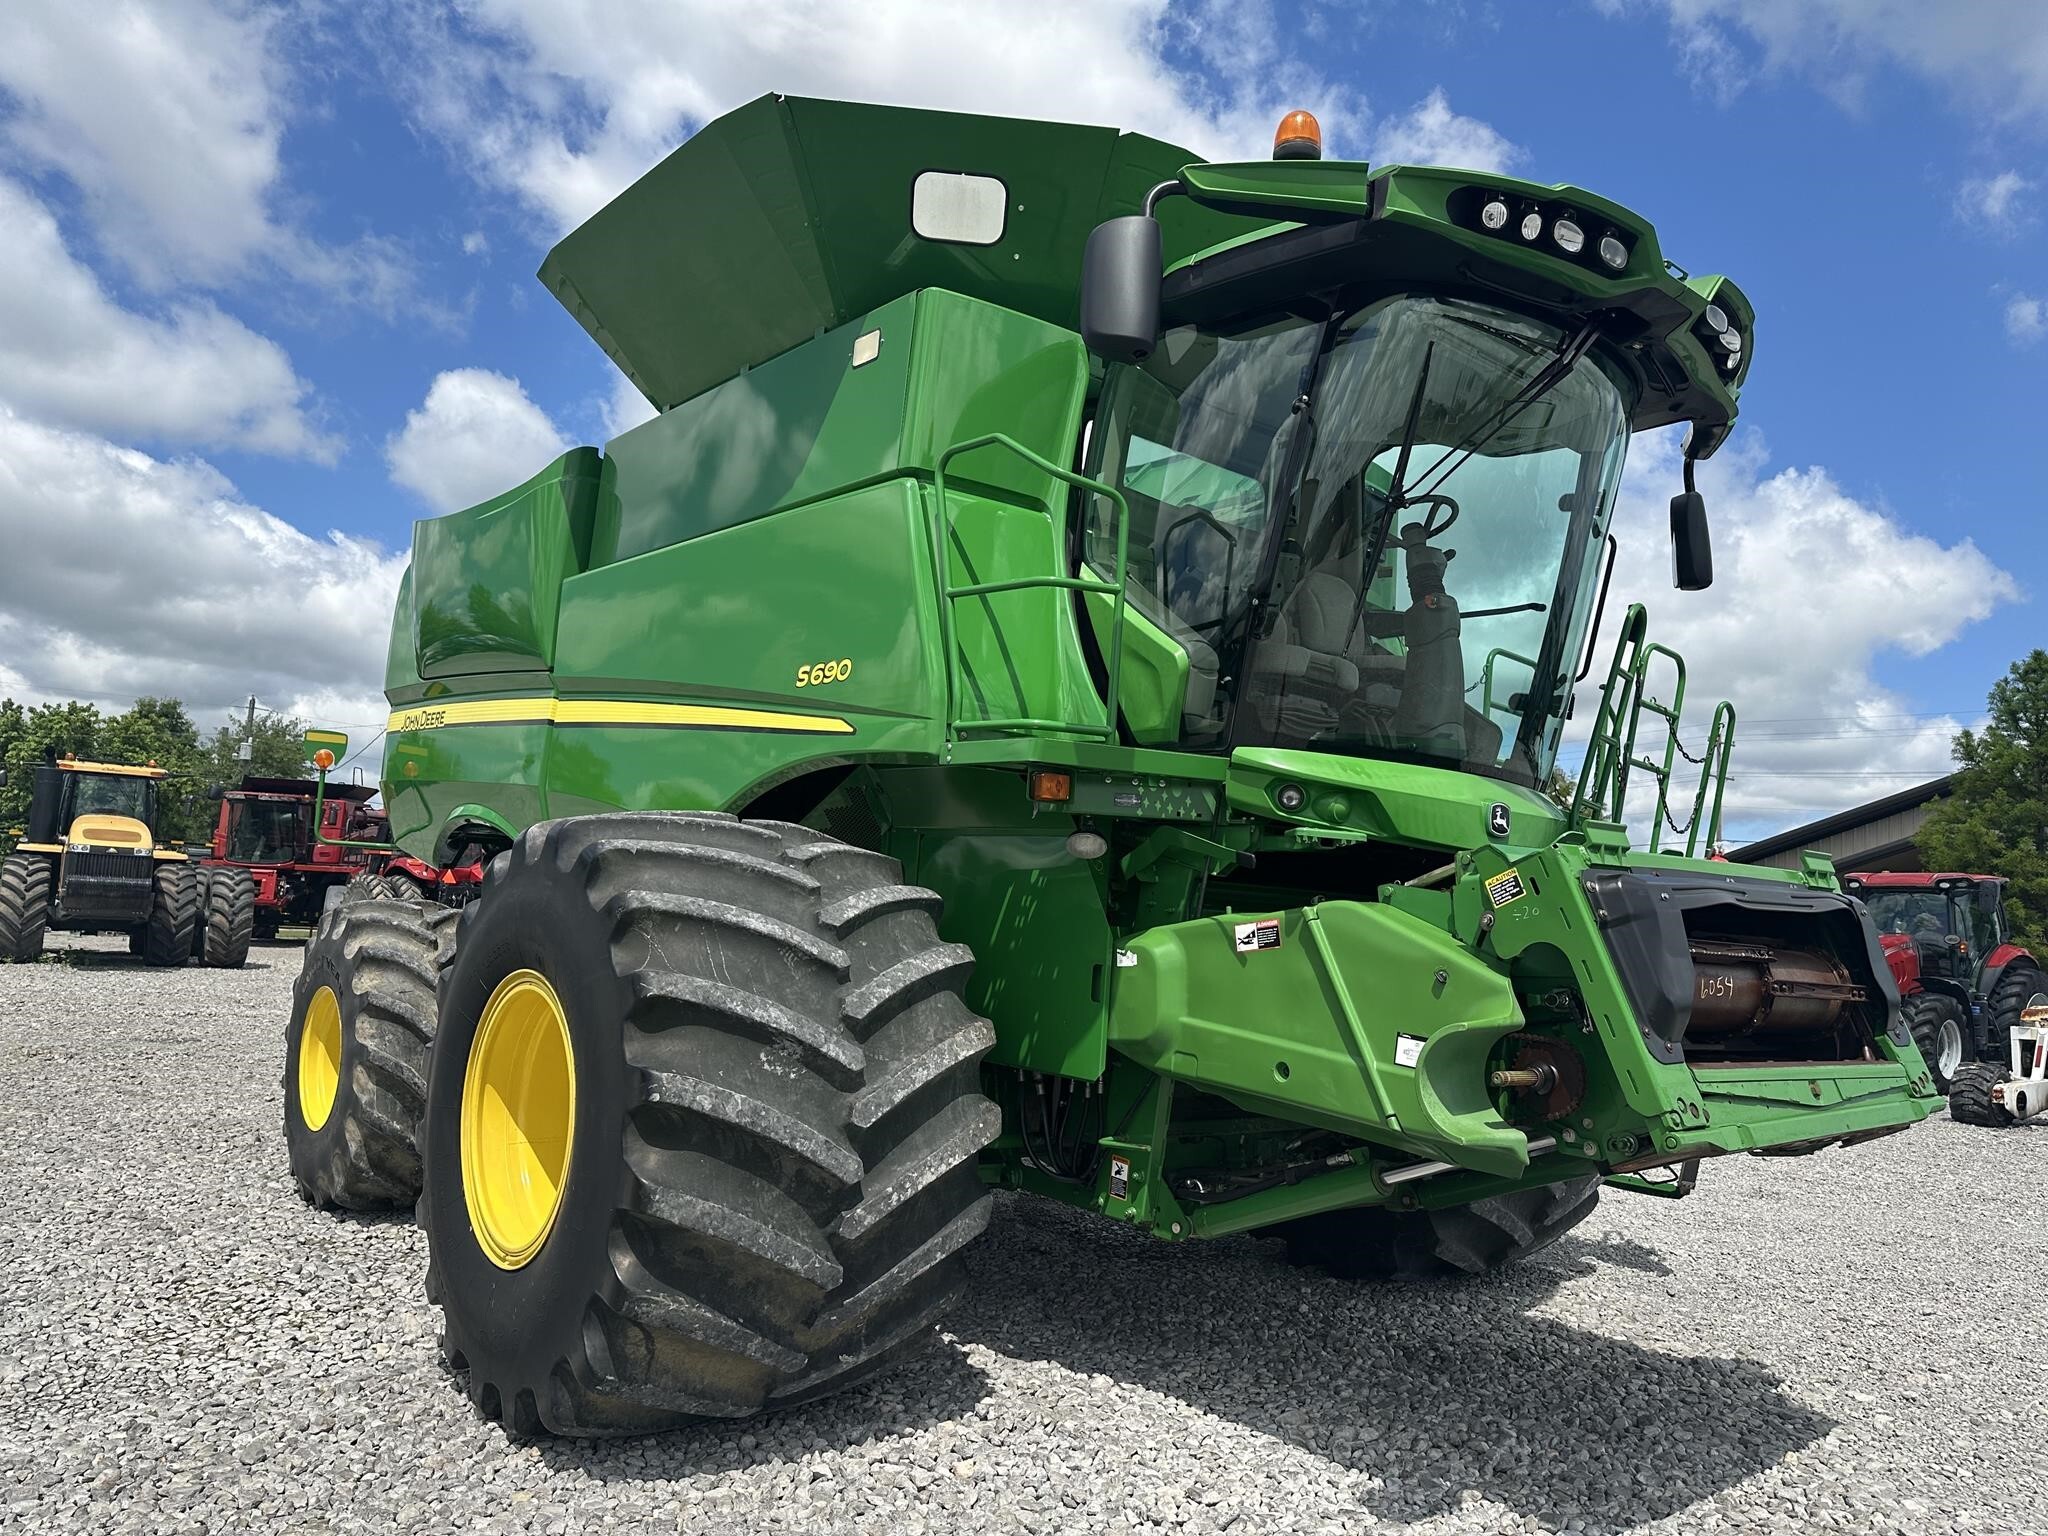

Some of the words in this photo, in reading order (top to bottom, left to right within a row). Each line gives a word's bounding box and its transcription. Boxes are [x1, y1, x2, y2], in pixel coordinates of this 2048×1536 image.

[795, 658, 852, 688] S690
[401, 714, 420, 730] JOHN
[420, 711, 446, 727] DEERE
[1491, 869, 1516, 884] CAUTION
[1701, 976, 1733, 999] 6054
